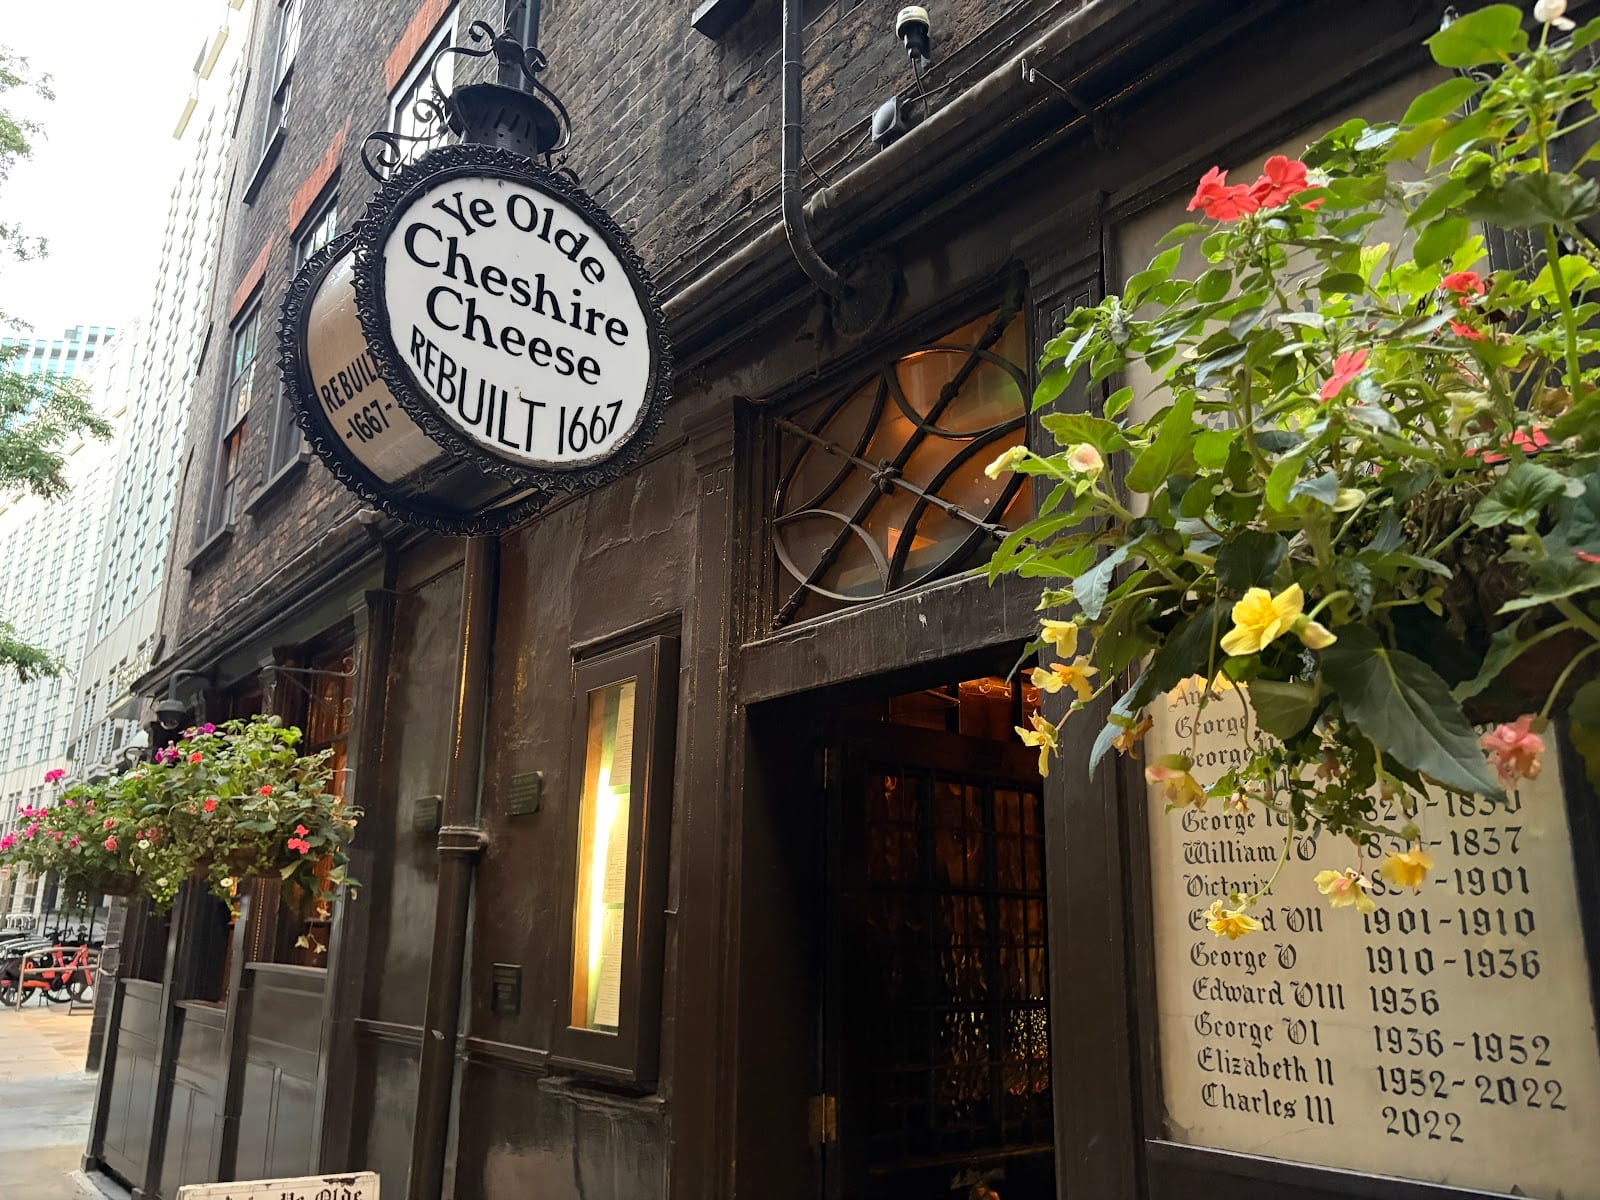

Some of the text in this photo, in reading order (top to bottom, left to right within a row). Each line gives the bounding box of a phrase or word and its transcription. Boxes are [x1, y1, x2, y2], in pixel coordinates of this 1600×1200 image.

[432, 192, 606, 285] Ye Olde
[404, 222, 629, 346] Cheshire
[426, 286, 601, 385] Cheese
[410, 324, 623, 455] REBUILT 1667
[1182, 808, 1256, 836] George
[1183, 839, 1277, 864] William
[1281, 906, 1323, 932] VII
[1190, 941, 1267, 975] George
[1192, 976, 1440, 1016] Edward VIII 1936
[1194, 1010, 1273, 1049] George
[1282, 1017, 1320, 1046] VI
[1197, 1046, 1308, 1082] Elizabeth
[1316, 1057, 1334, 1086] II
[1202, 1082, 1464, 1143] Charles III 2022
